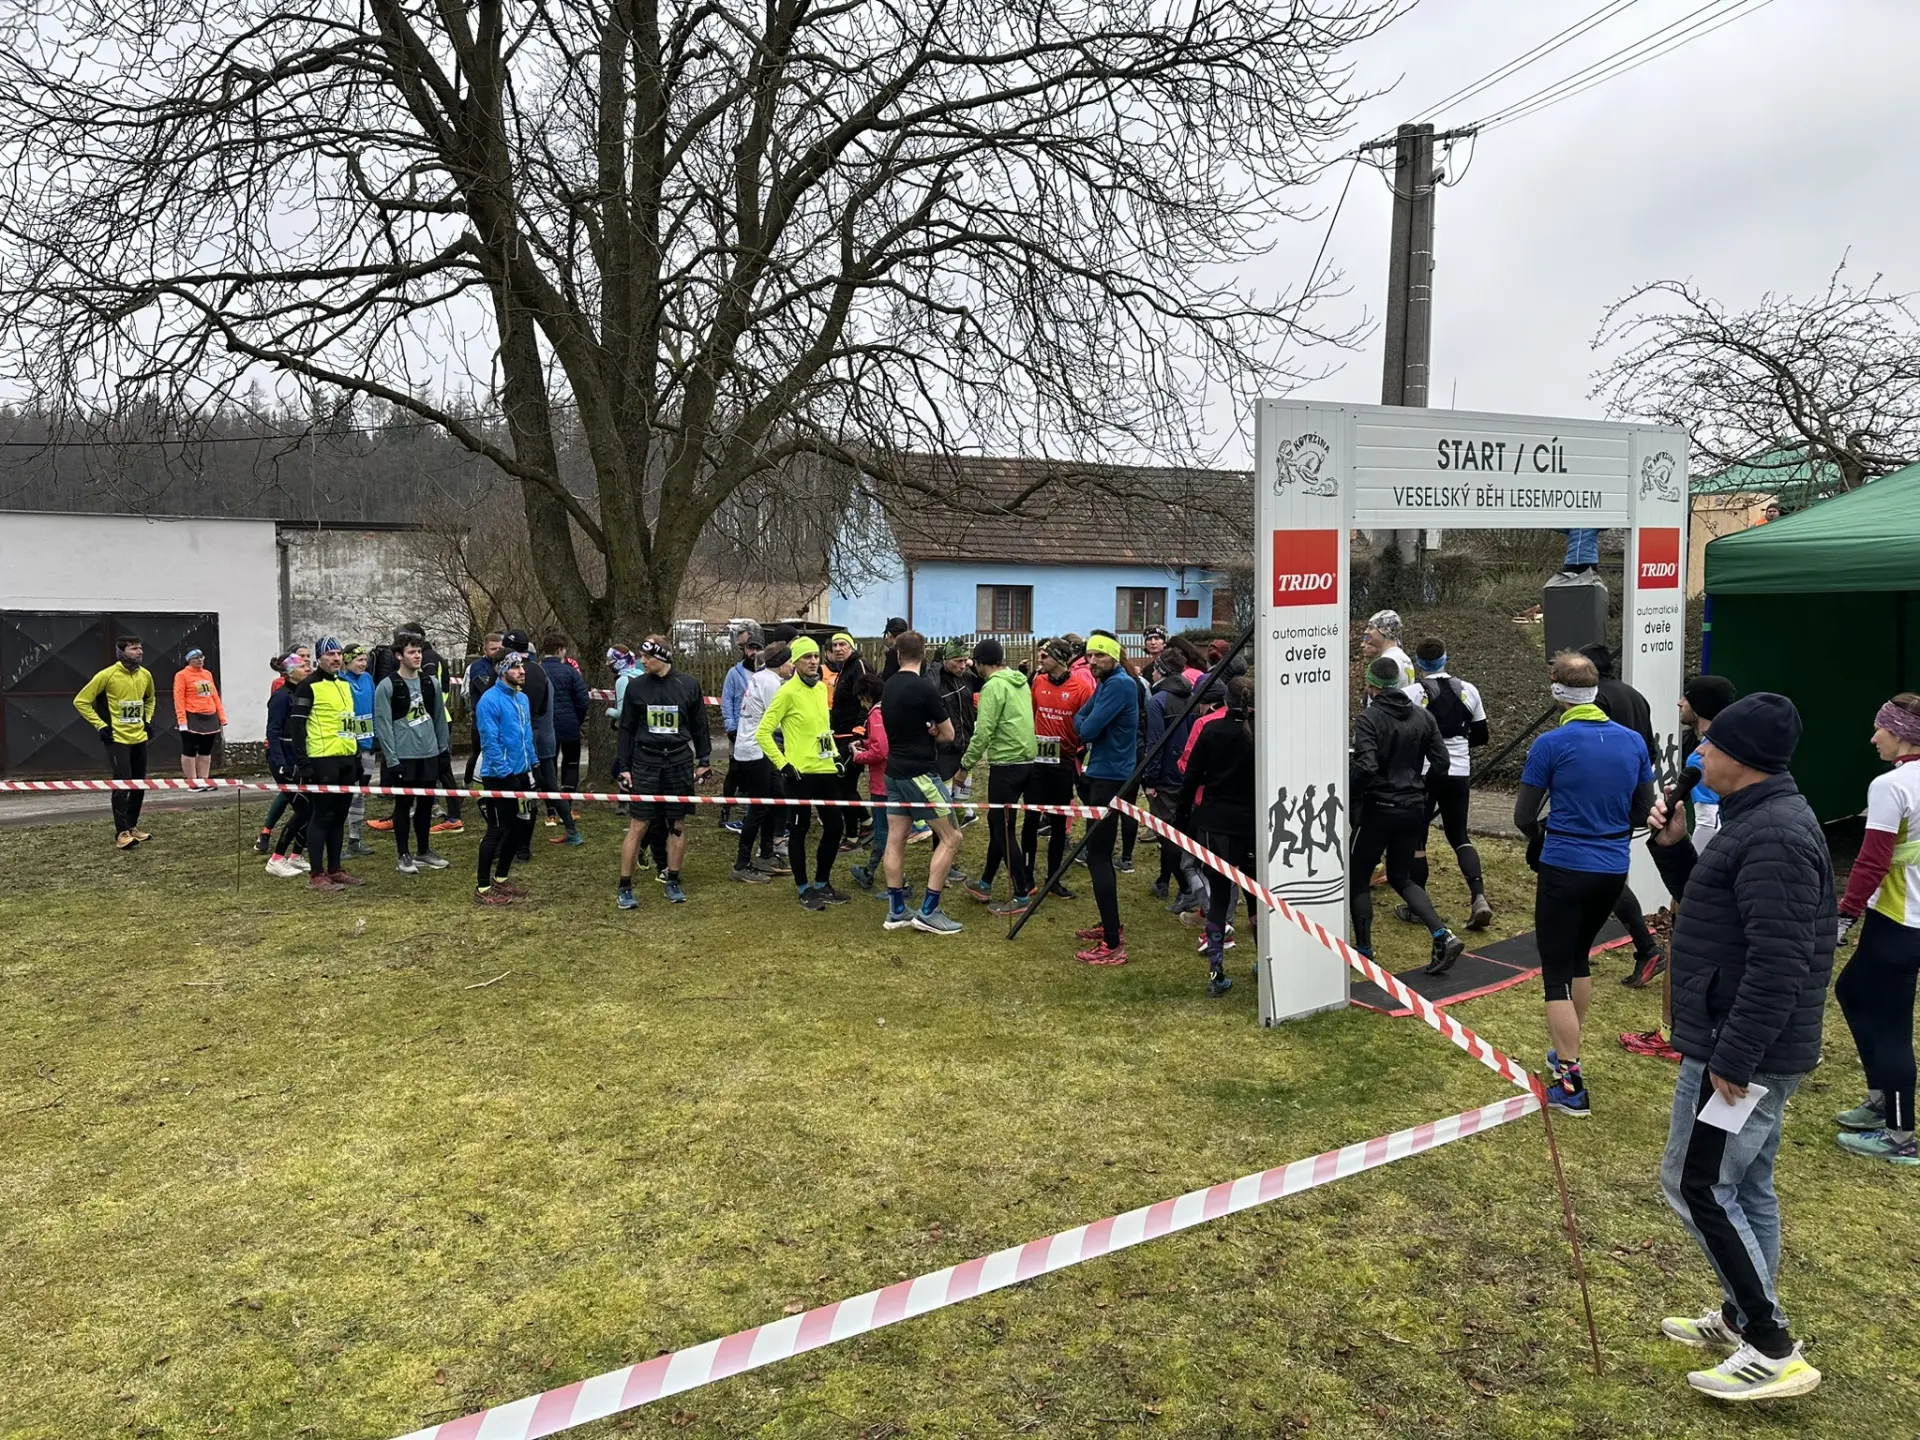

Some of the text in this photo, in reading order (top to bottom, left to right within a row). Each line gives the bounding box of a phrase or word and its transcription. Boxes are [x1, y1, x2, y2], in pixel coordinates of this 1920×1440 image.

[1437, 436, 1568, 475] START / CÍL
[1393, 482, 1602, 509] VESELSKÝ BĚH LESEMPOLEM
[1636, 603, 1679, 616] automatické
[1272, 623, 1339, 640] automatické
[1644, 620, 1671, 634] dveře
[1285, 644, 1327, 662] dveře
[1641, 639, 1673, 653] a vrata
[1280, 667, 1331, 686] a vrata
[121, 706, 141, 718] 123
[651, 712, 674, 728] 119
[1037, 742, 1056, 757] 114
